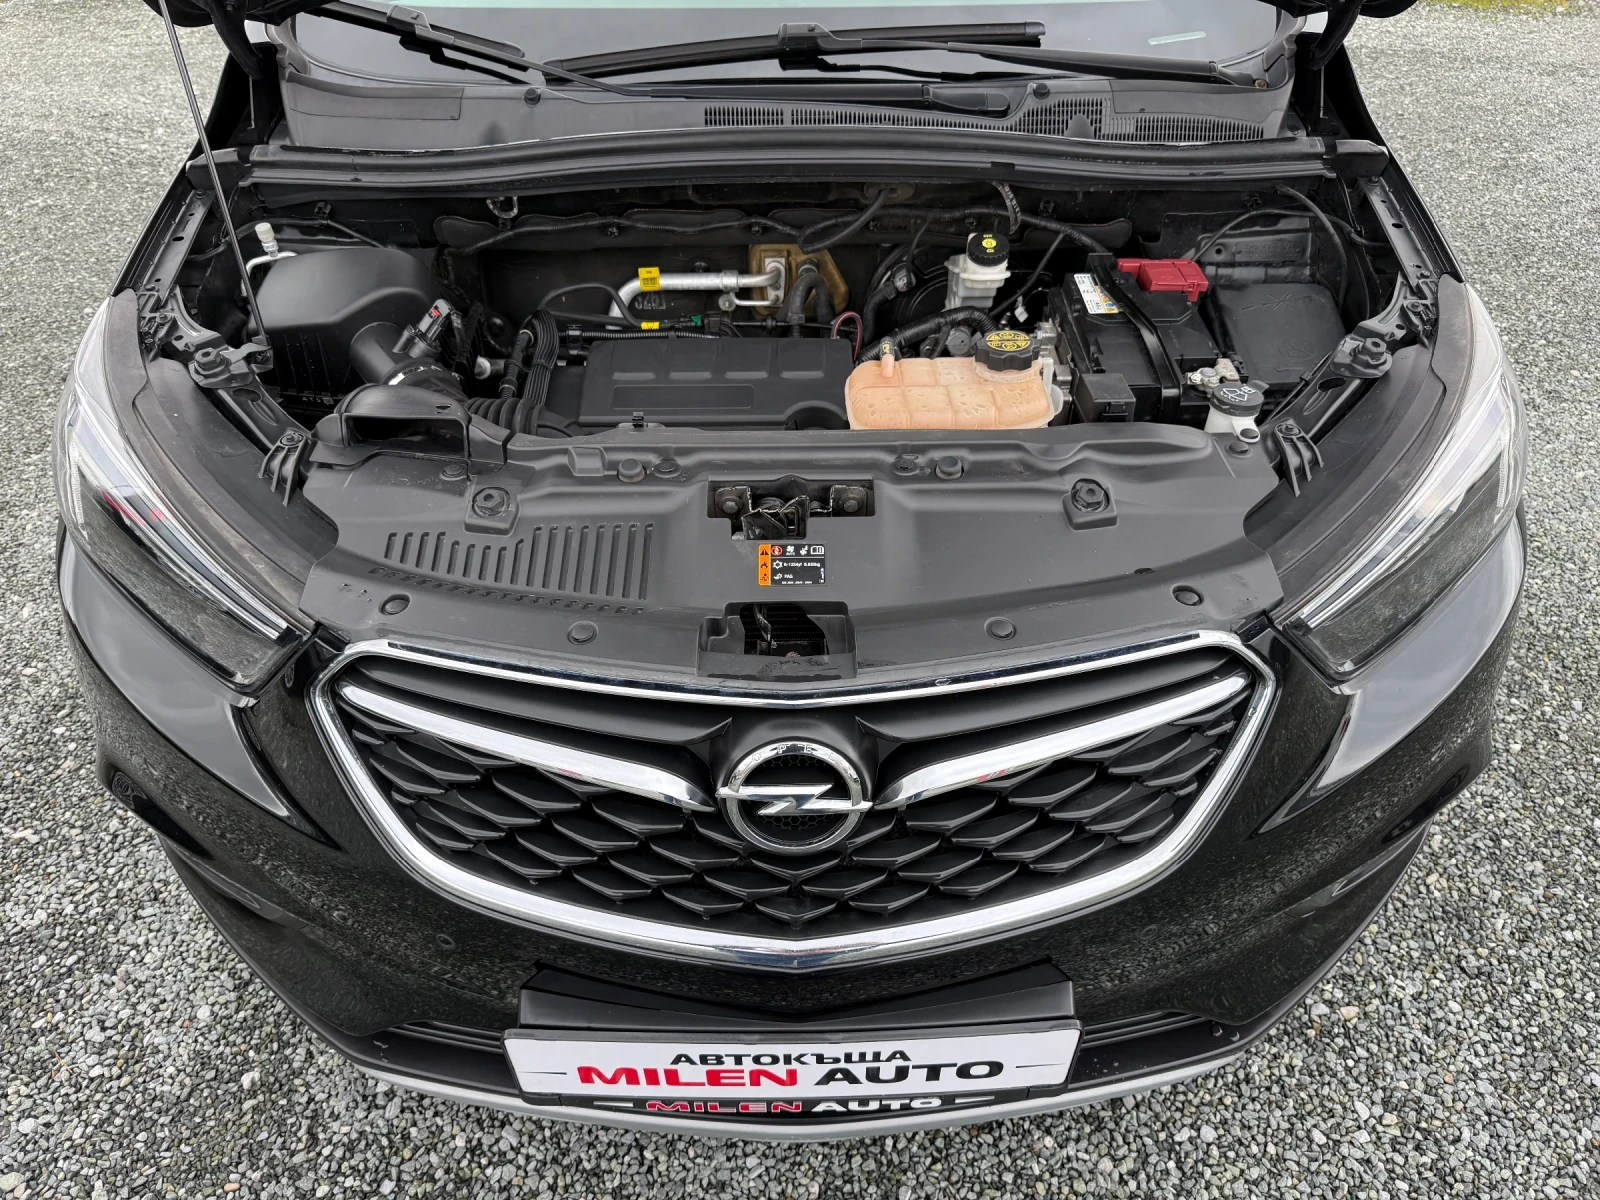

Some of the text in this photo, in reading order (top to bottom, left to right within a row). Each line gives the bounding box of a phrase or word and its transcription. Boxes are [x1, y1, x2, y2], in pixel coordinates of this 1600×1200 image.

[577, 1060, 1004, 1087] MILEN AUTO
[646, 1097, 942, 1113] MILEN AUTO
